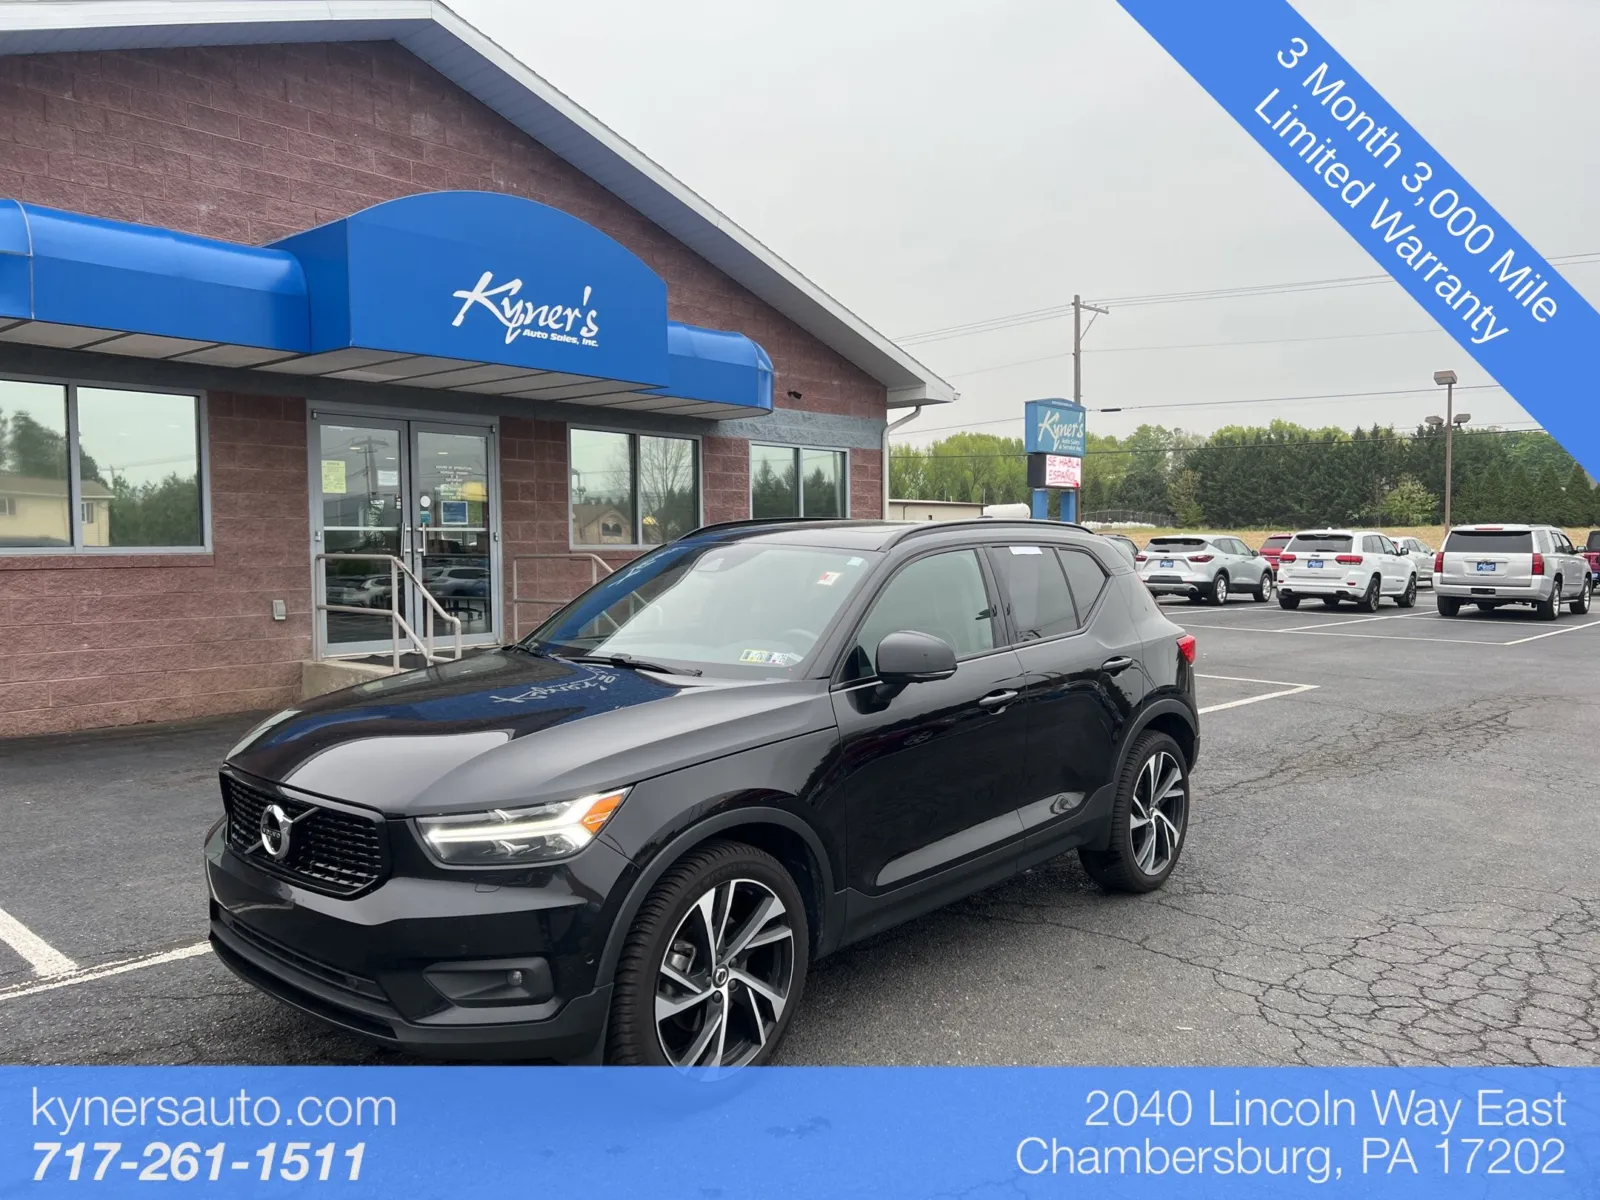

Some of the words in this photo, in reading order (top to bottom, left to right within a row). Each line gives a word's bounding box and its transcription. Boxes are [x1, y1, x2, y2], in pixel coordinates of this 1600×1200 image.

[451, 271, 599, 345] Kyner's
[522, 328, 549, 340] Auto
[549, 332, 580, 346] Sales,
[582, 337, 599, 348] Inc.
[1038, 410, 1084, 452] Kyner's
[1048, 456, 1057, 467] SE
[1059, 457, 1080, 469] HABLA
[262, 827, 281, 839] VOLVO
